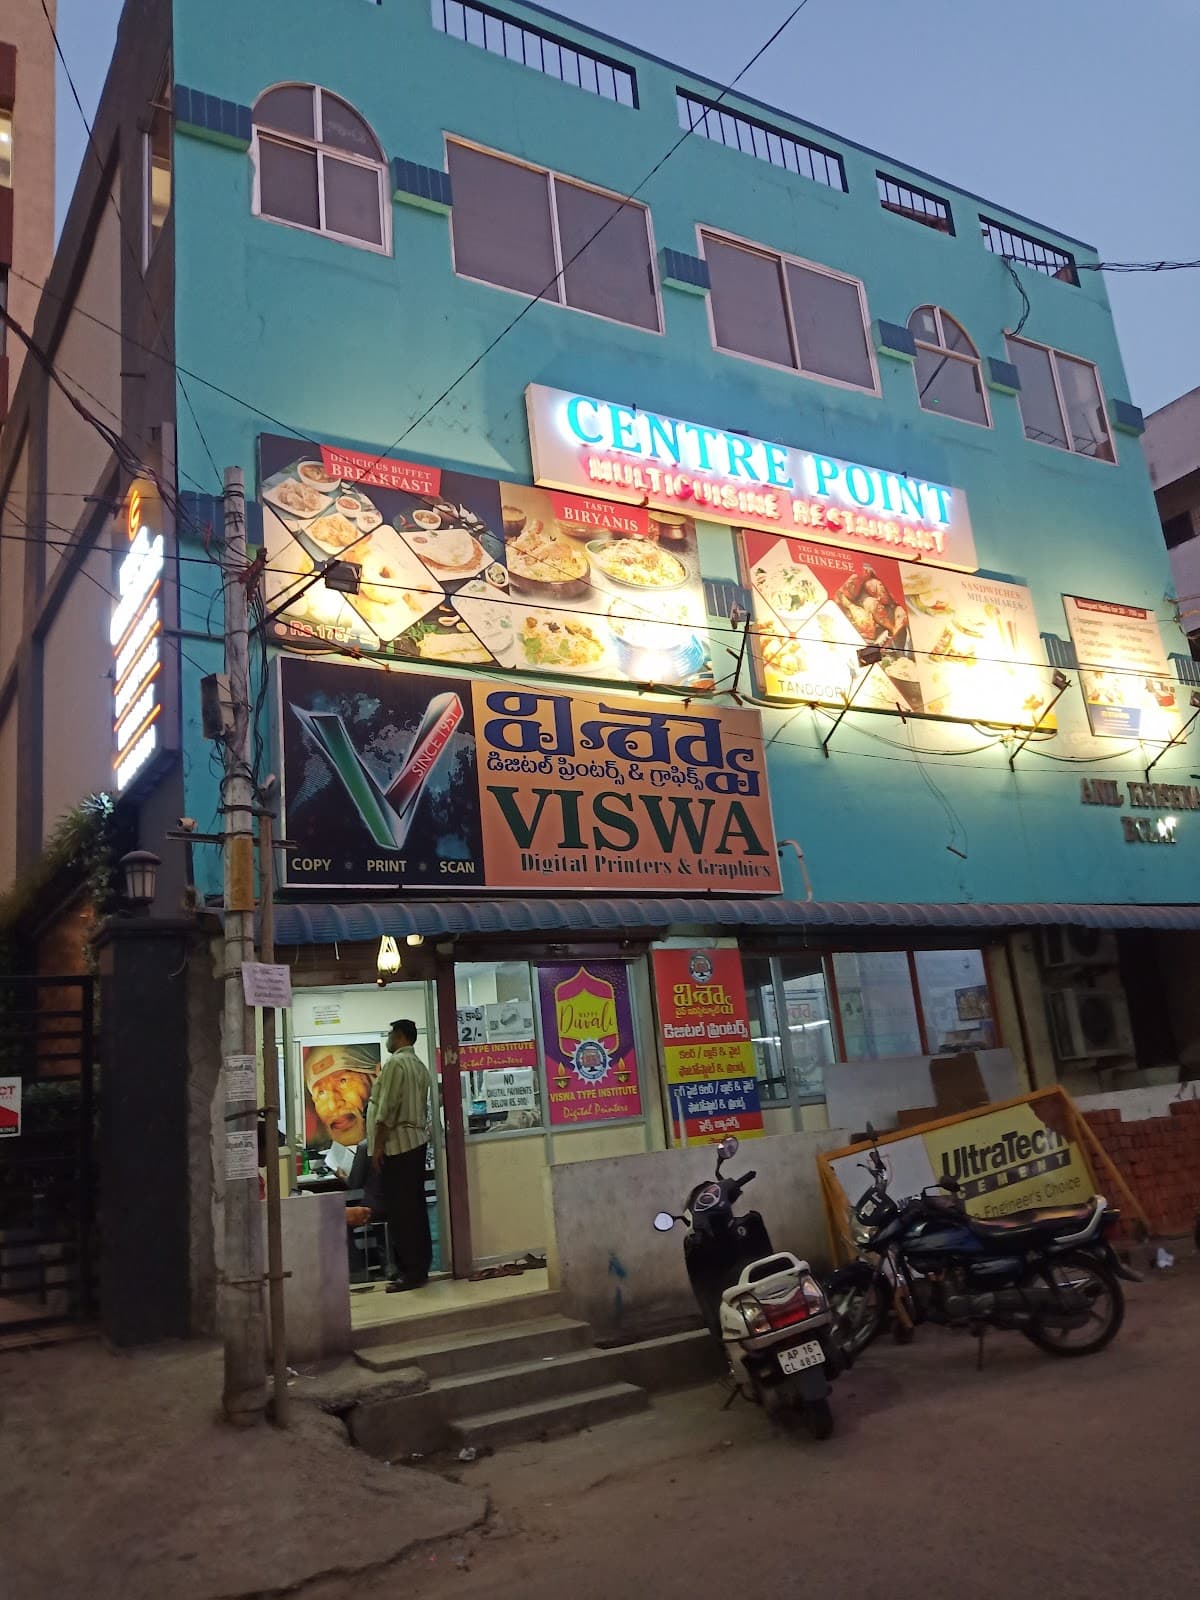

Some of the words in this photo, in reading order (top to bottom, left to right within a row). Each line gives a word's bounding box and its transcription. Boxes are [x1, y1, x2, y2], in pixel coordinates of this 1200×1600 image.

[331, 453, 388, 471] DELICIOUS
[391, 465, 432, 480] BUFFET
[567, 395, 793, 490] CENTRE
[815, 455, 952, 525] POINT
[332, 463, 433, 493] BREAKFAST
[583, 500, 616, 514] TASTY
[564, 505, 639, 532] BIRYANIS
[793, 499, 945, 555] RESTAURANT
[798, 545, 812, 553] VEG
[798, 553, 855, 572] CHINEESE
[961, 580, 1020, 599] SANDWICHES
[411, 739, 442, 777] SINCE
[440, 710, 460, 738] 1951
[486, 750, 552, 775] డిజిటల్
[629, 763, 644, 781] &
[487, 785, 769, 856] VISWA
[291, 858, 332, 872] COPY
[367, 860, 407, 873] PRINT
[440, 861, 475, 874] SCAN
[522, 852, 588, 875] Digital
[595, 857, 673, 878] Printers
[678, 859, 692, 876] &
[698, 858, 772, 881] Graphics
[462, 1027, 482, 1042] 2/-
[469, 1045, 489, 1054] TYPE
[491, 1041, 535, 1052] INSTITUTE
[503, 1074, 515, 1085] NO
[550, 1093, 575, 1103] VISWA
[576, 1089, 598, 1099] TYPE
[598, 1086, 638, 1096] INSTITUTE
[563, 1103, 592, 1121] Digital
[594, 1102, 629, 1116] Printers
[957, 1152, 1065, 1200] CEMENT
[983, 1187, 1042, 1218] Engineer's
[1046, 1175, 1081, 1199] Choice
[787, 1349, 798, 1361] AP
[803, 1344, 813, 1355] 16
[784, 1362, 798, 1373] CL
